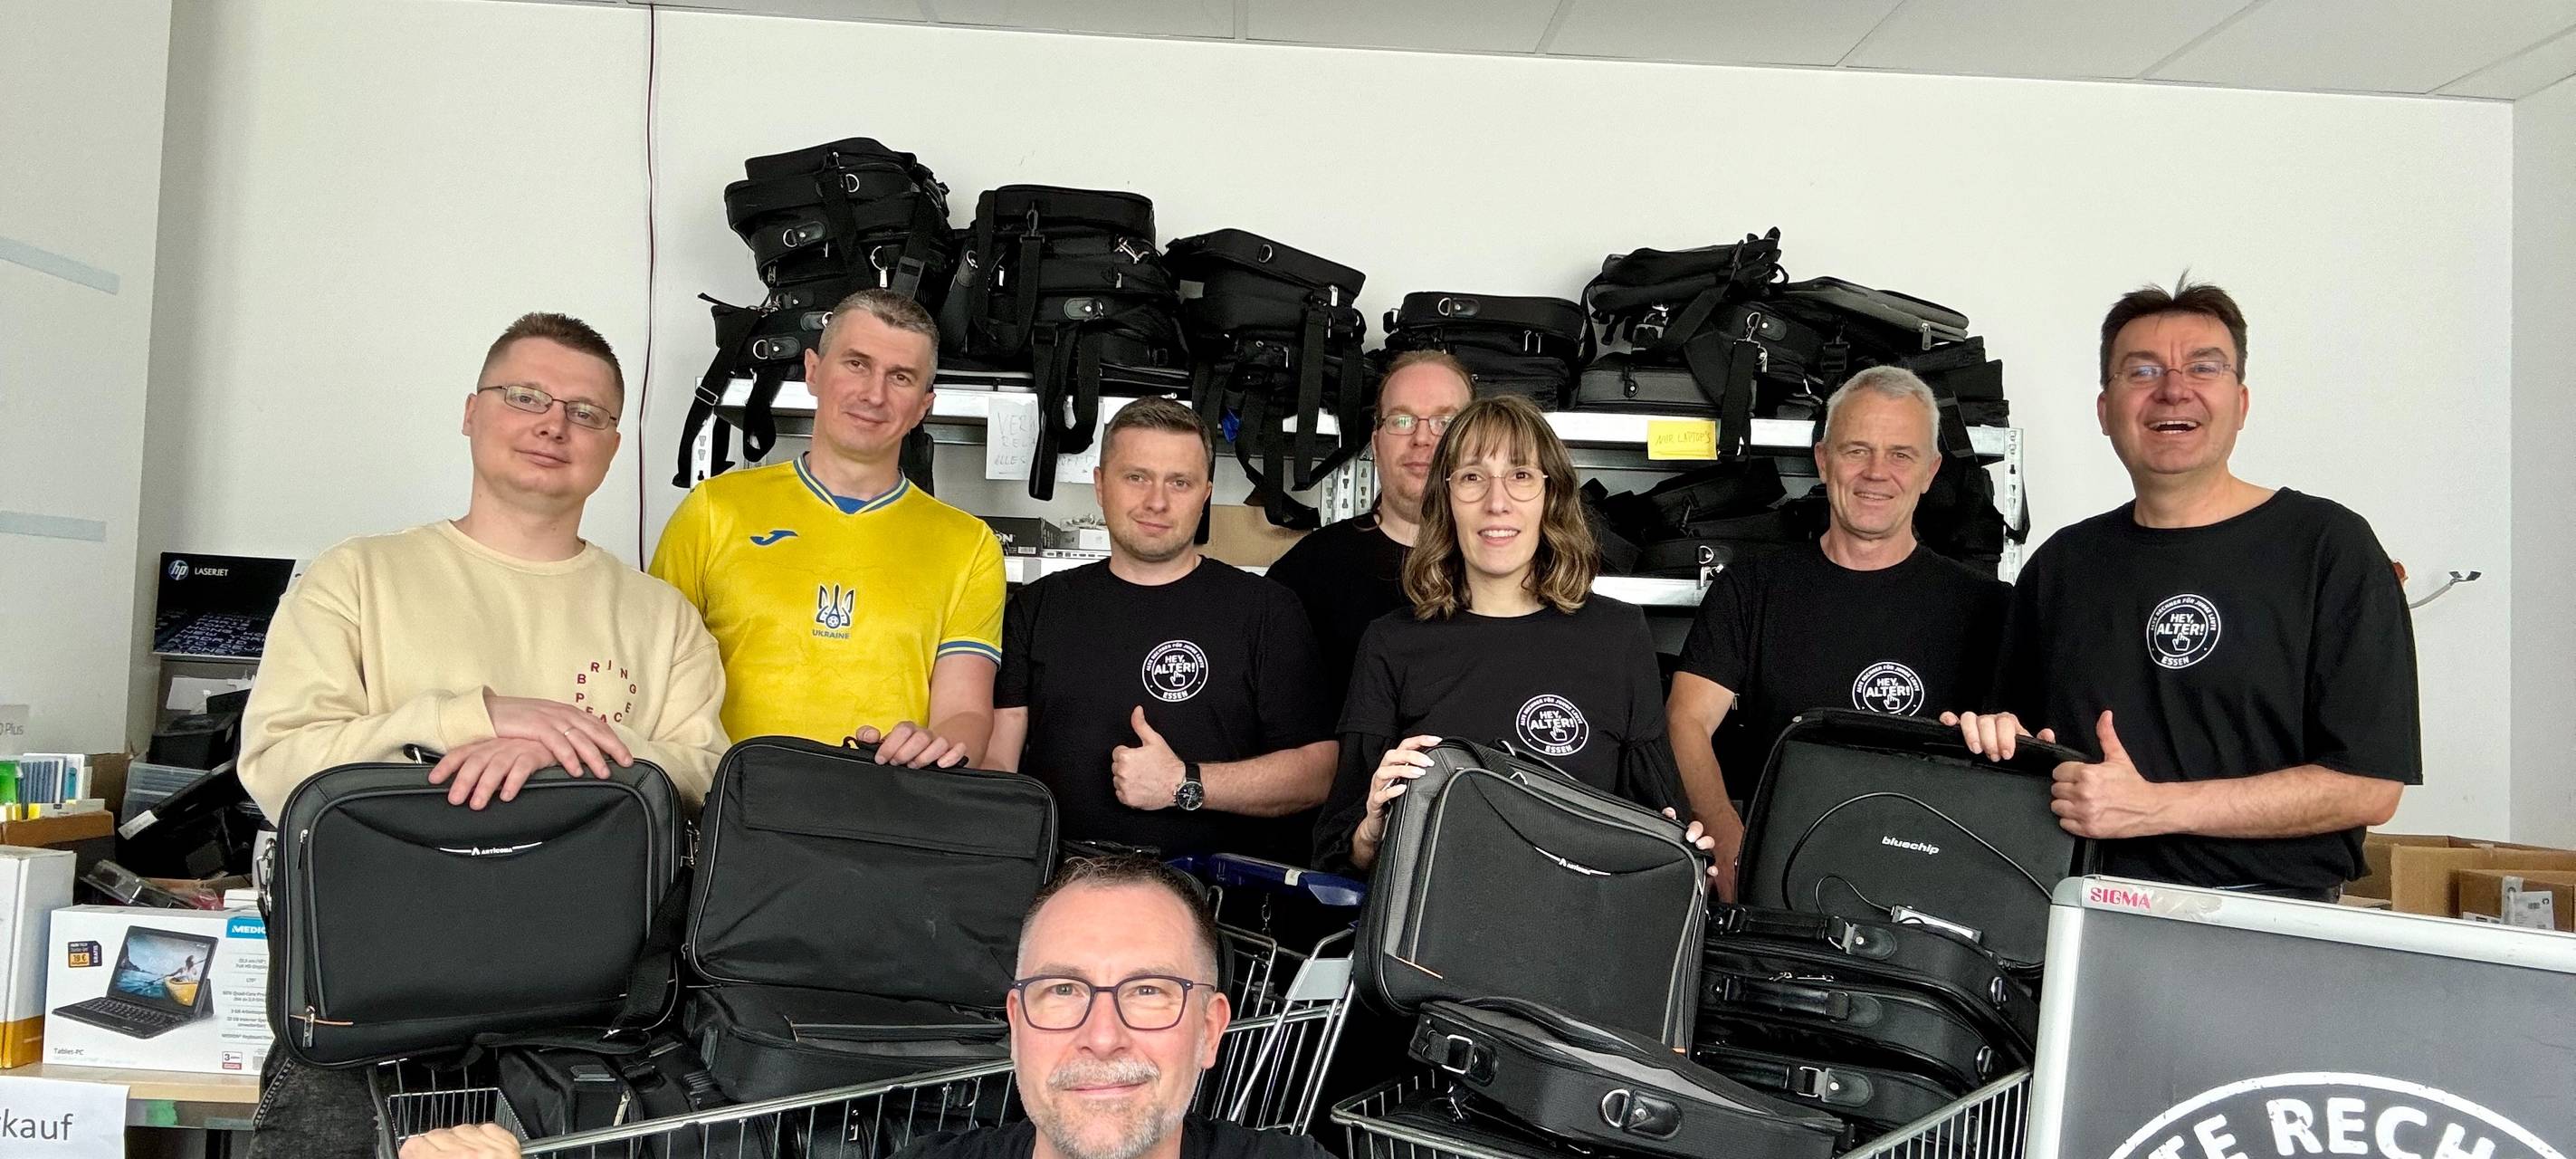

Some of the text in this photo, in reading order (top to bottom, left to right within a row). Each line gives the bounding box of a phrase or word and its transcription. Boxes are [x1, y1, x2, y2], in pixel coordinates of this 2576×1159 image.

[171, 560, 188, 580] hp
[194, 567, 229, 577] LASERJET
[2170, 613, 2195, 624] HEY,
[812, 628, 851, 640] UKRAINE
[2156, 623, 2206, 636] ALTER!
[1164, 655, 1186, 664] HEY,
[2161, 656, 2190, 666] ESSEN
[1154, 662, 1195, 675] ALTER!
[577, 660, 637, 694] BRING
[1876, 677, 1899, 686] HEY,
[1162, 690, 1188, 700] ESSEN
[1865, 685, 1911, 698] ALTER!
[576, 693, 632, 723] PEACE
[1539, 710, 1562, 720] HEY,
[5, 723, 24, 736] Plus
[1530, 718, 1575, 730] ALTER!
[1544, 744, 1573, 753] ESSEN
[1881, 836, 1940, 855] bluechip
[2090, 887, 2151, 910] SIGMA
[224, 1053, 231, 1061] 3
[0, 1108, 74, 1141] kauf
[2266, 1097, 2496, 1159] RECH
